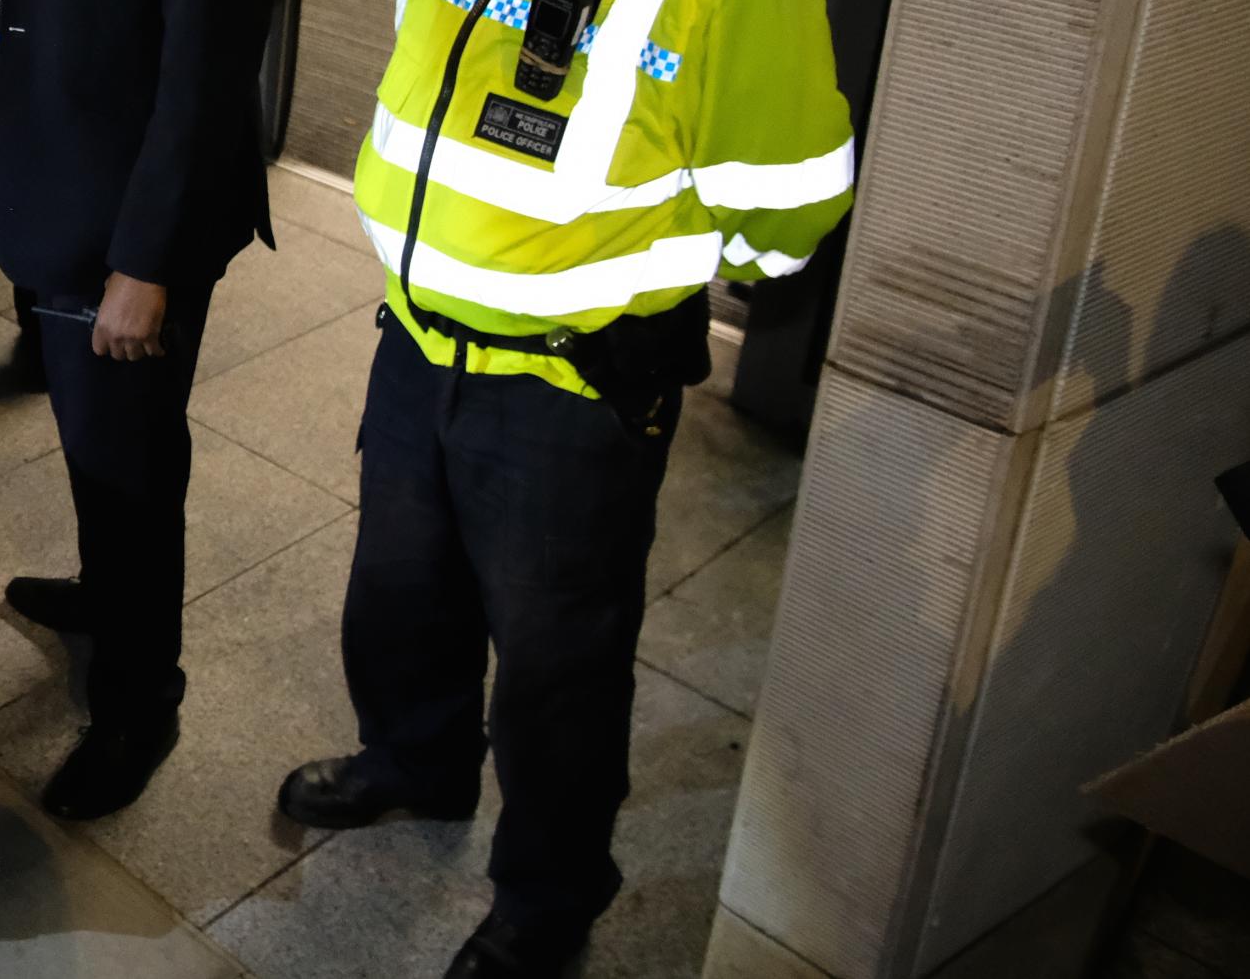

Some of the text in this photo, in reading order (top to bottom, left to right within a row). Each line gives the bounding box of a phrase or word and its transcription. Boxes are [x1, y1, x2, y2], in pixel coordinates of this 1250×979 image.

[482, 124, 553, 156] POLICE OFFICER
[518, 121, 548, 137] POLICE
